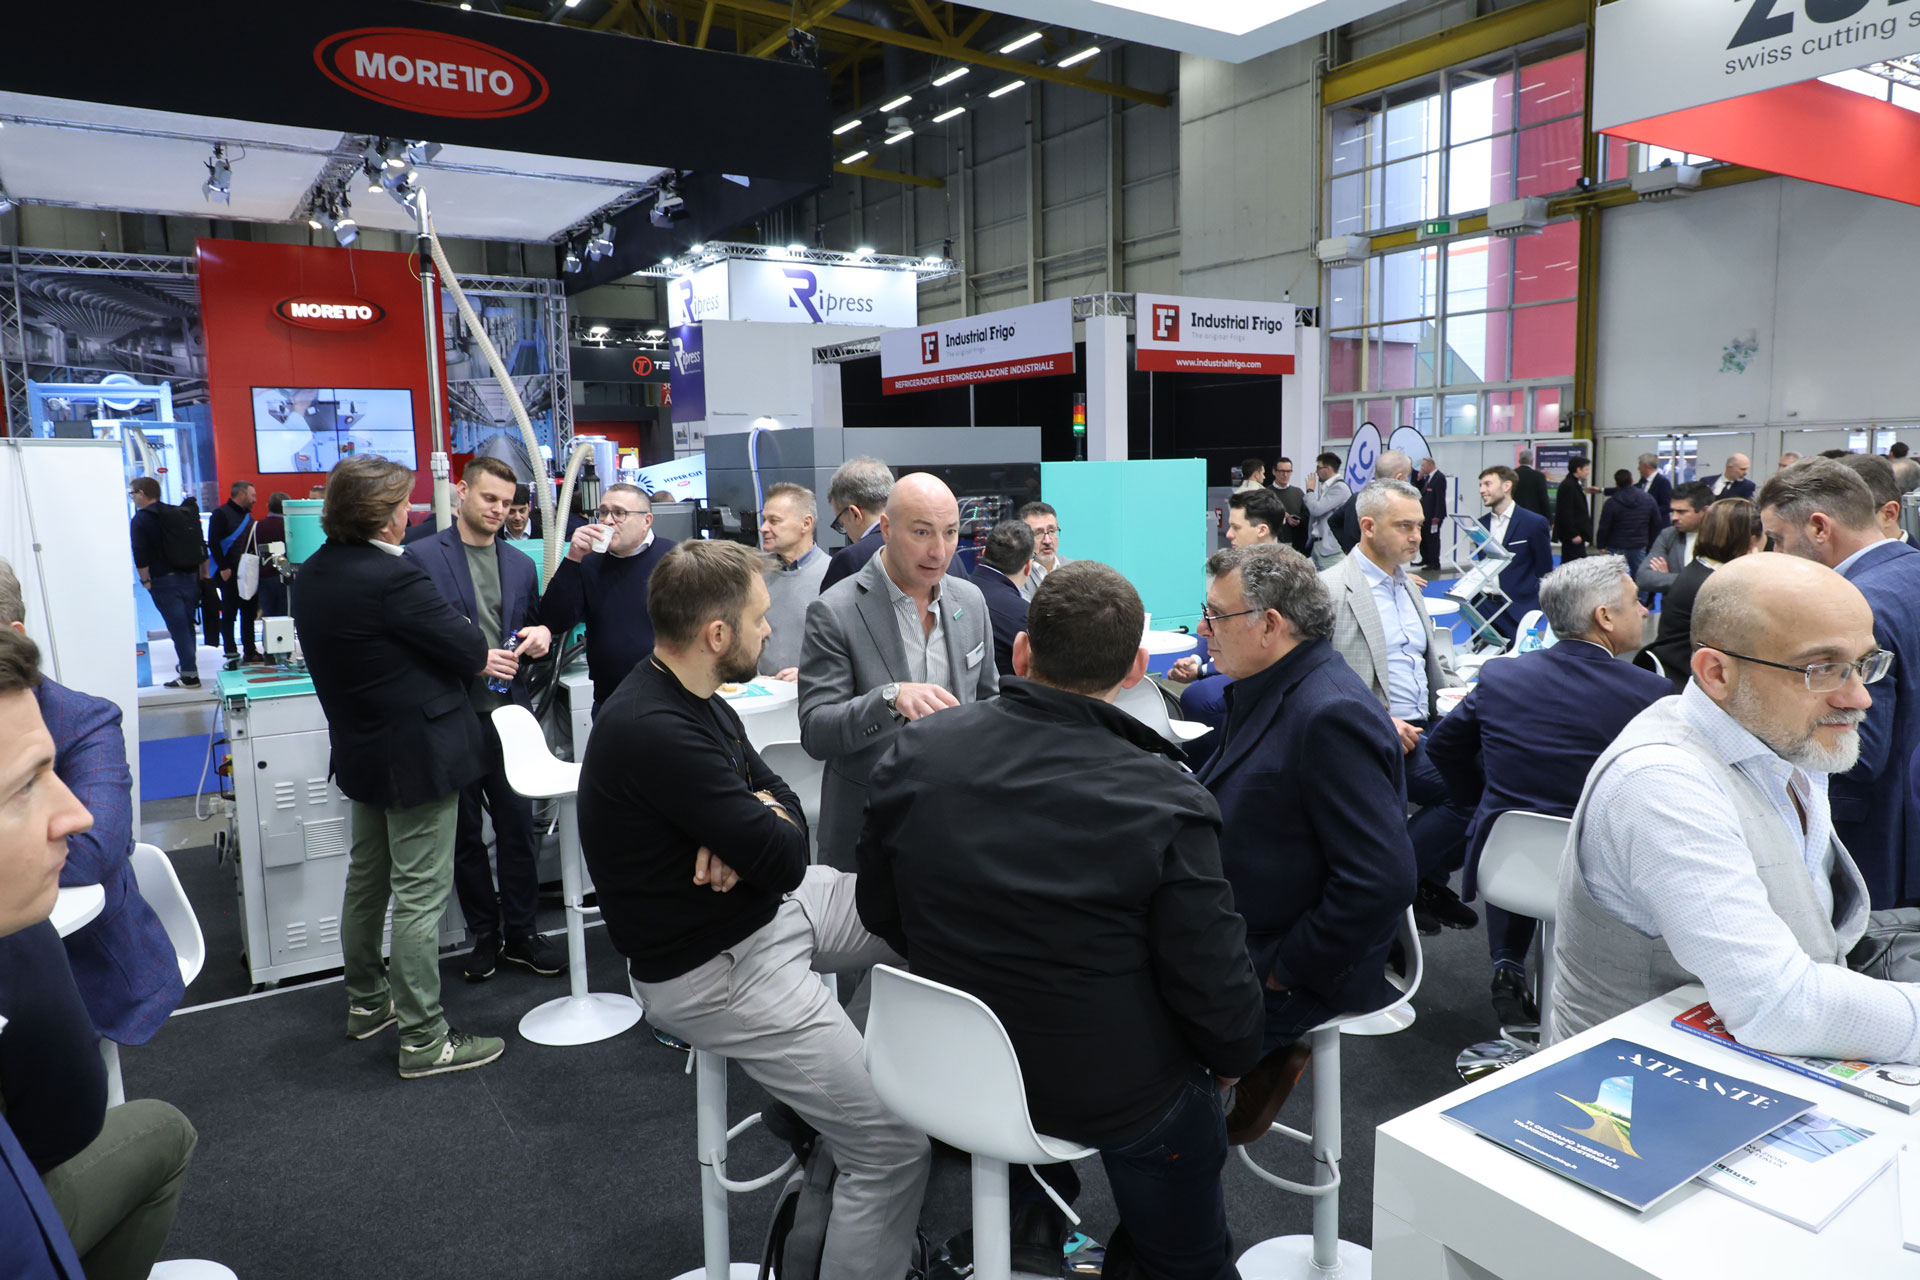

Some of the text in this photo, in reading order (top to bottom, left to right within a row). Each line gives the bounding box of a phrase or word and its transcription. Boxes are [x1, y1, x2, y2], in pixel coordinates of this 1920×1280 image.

[1725, 46, 1792, 75] swiss
[1801, 17, 1897, 55] cutting
[355, 49, 514, 97] MORETTO
[290, 303, 373, 320] MORETTO
[679, 279, 720, 323] Ripress
[782, 268, 873, 323] Ripress
[945, 324, 1015, 348] Industrial Frigo
[1191, 312, 1283, 334] Industrial Frigo
[895, 361, 1055, 389] REFRIGERAZIONE E TERMOREGOLAZIONE INDUSTRIALE
[1176, 358, 1262, 370] www.industrialfrigo.com
[1617, 1053, 1779, 1109] ATLANTE
[1513, 1119, 1620, 1170] TRANSIZIONE SOSTENIBILE
[1534, 1124, 1576, 1145] GUIDIAMO
[1576, 1142, 1605, 1157] VERSO
[1605, 1155, 1617, 1163] LA
